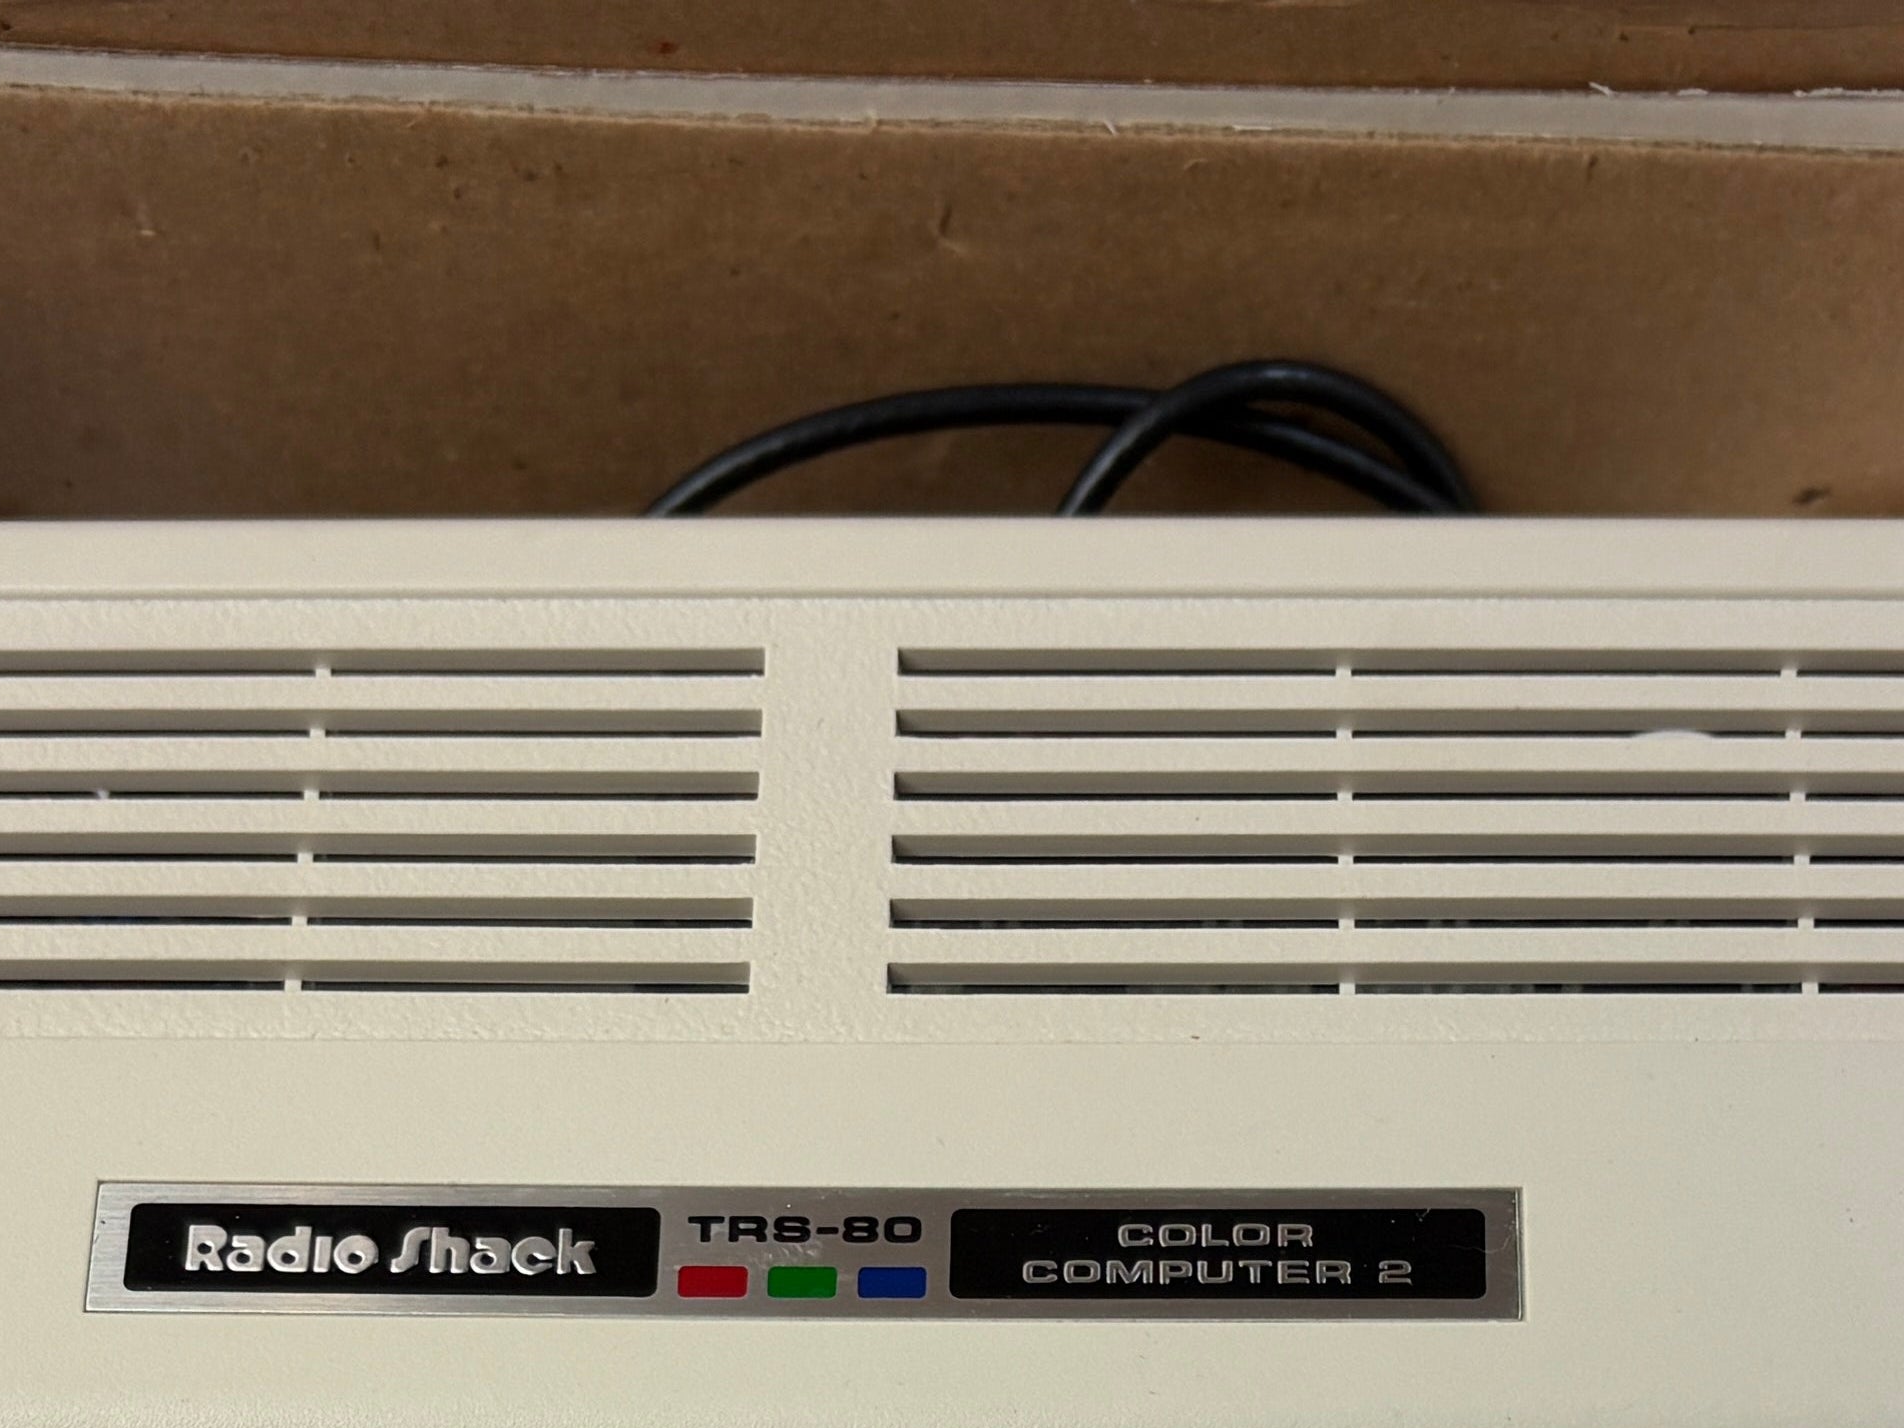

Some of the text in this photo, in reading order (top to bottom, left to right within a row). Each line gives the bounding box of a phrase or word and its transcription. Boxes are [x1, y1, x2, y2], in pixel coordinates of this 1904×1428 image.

[687, 1215, 922, 1244] TRS-80
[1116, 1223, 1313, 1249] COLOR
[183, 1224, 598, 1275] Radio Shack
[1020, 1259, 1414, 1286] COMPUTER 2
